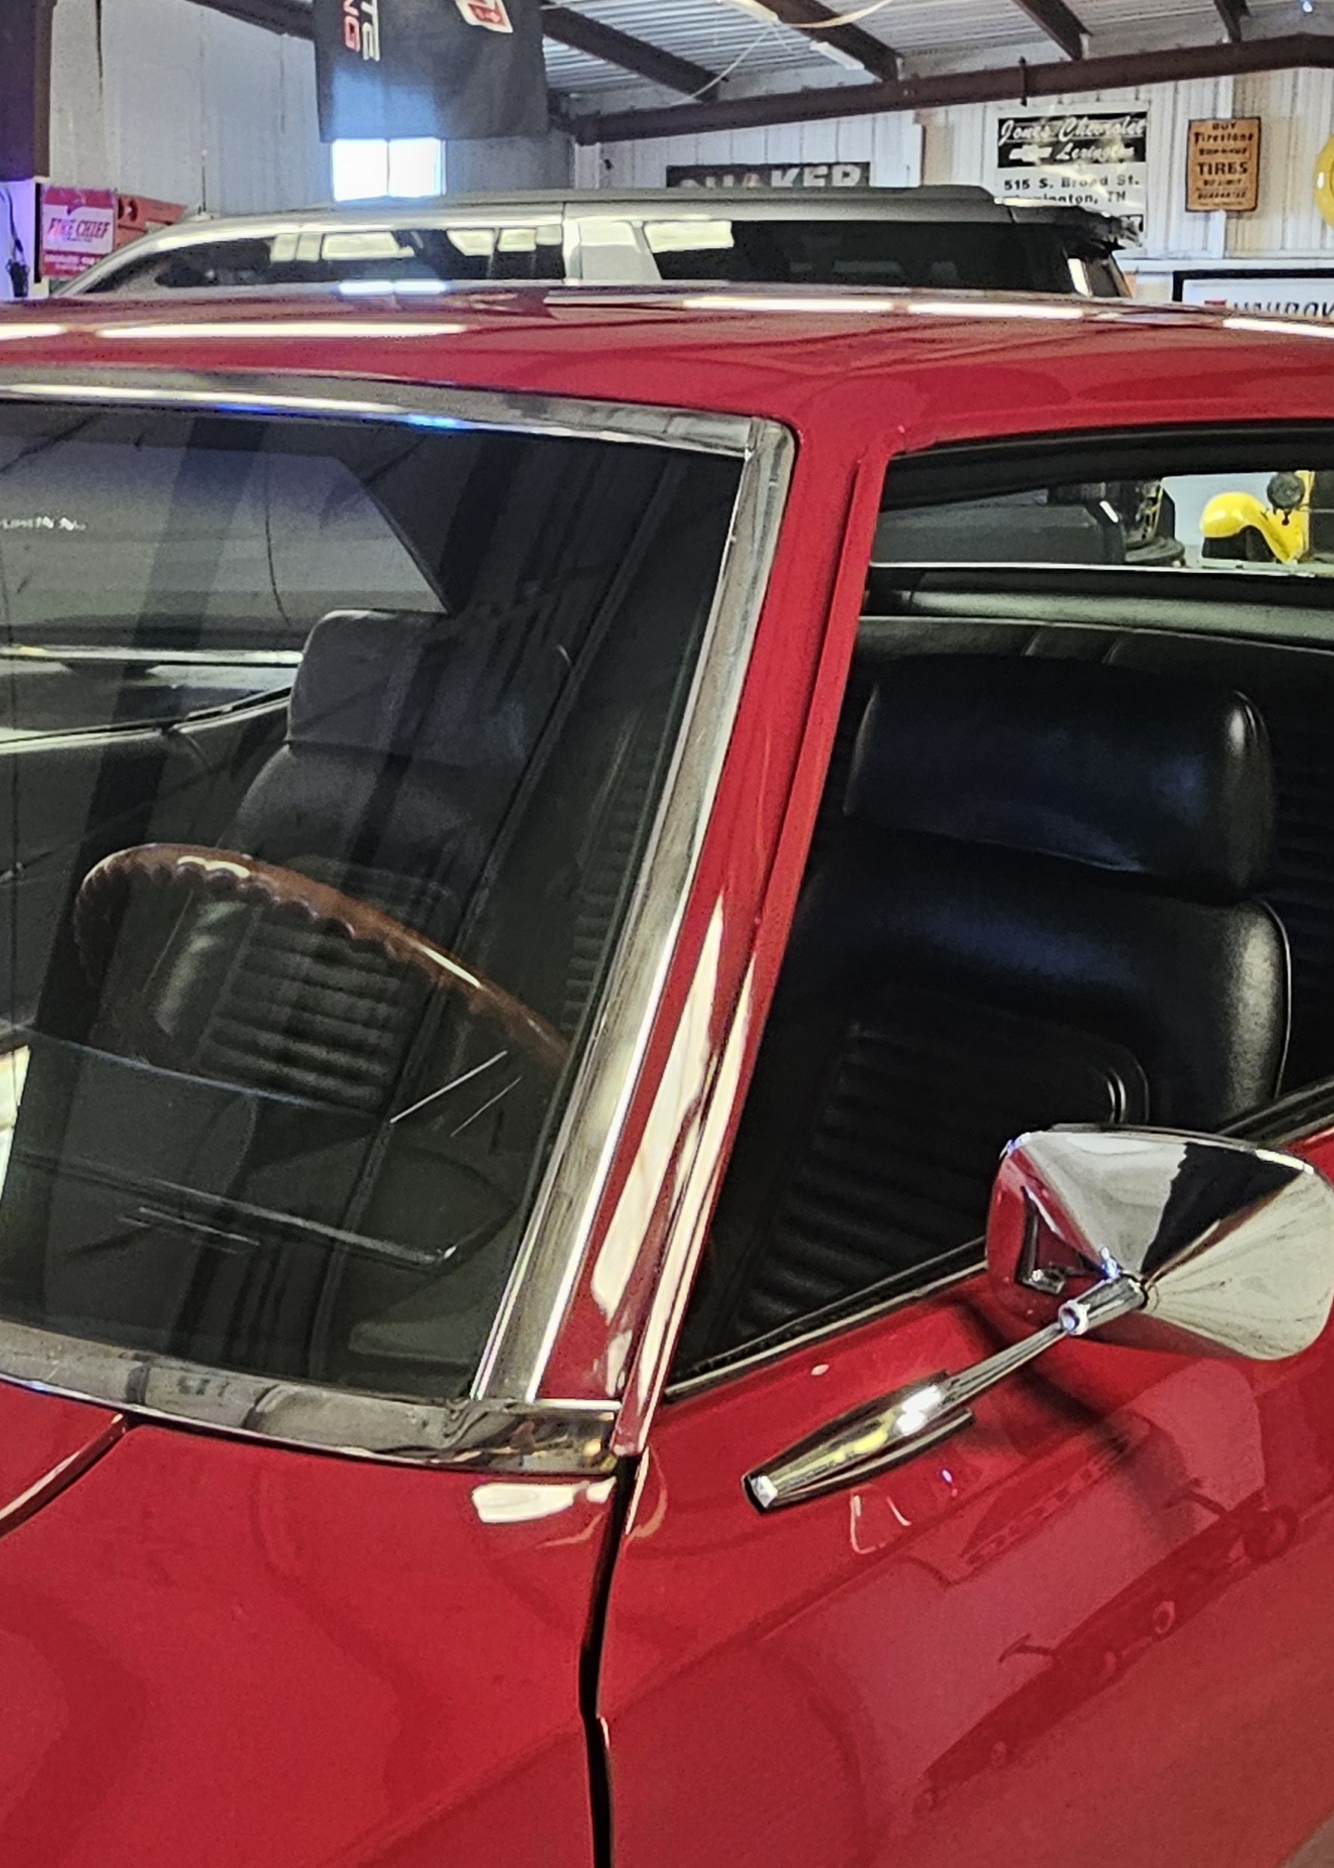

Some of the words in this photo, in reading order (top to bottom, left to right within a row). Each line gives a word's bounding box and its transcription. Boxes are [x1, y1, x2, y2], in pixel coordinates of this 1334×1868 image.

[1212, 122, 1237, 130] BUY
[998, 120, 1053, 147] Jones
[1198, 162, 1248, 175] TIRES
[1004, 179, 1030, 190] 515
[1039, 177, 1053, 189] S.
[1117, 174, 1140, 186] St.
[1107, 191, 1126, 203] TN
